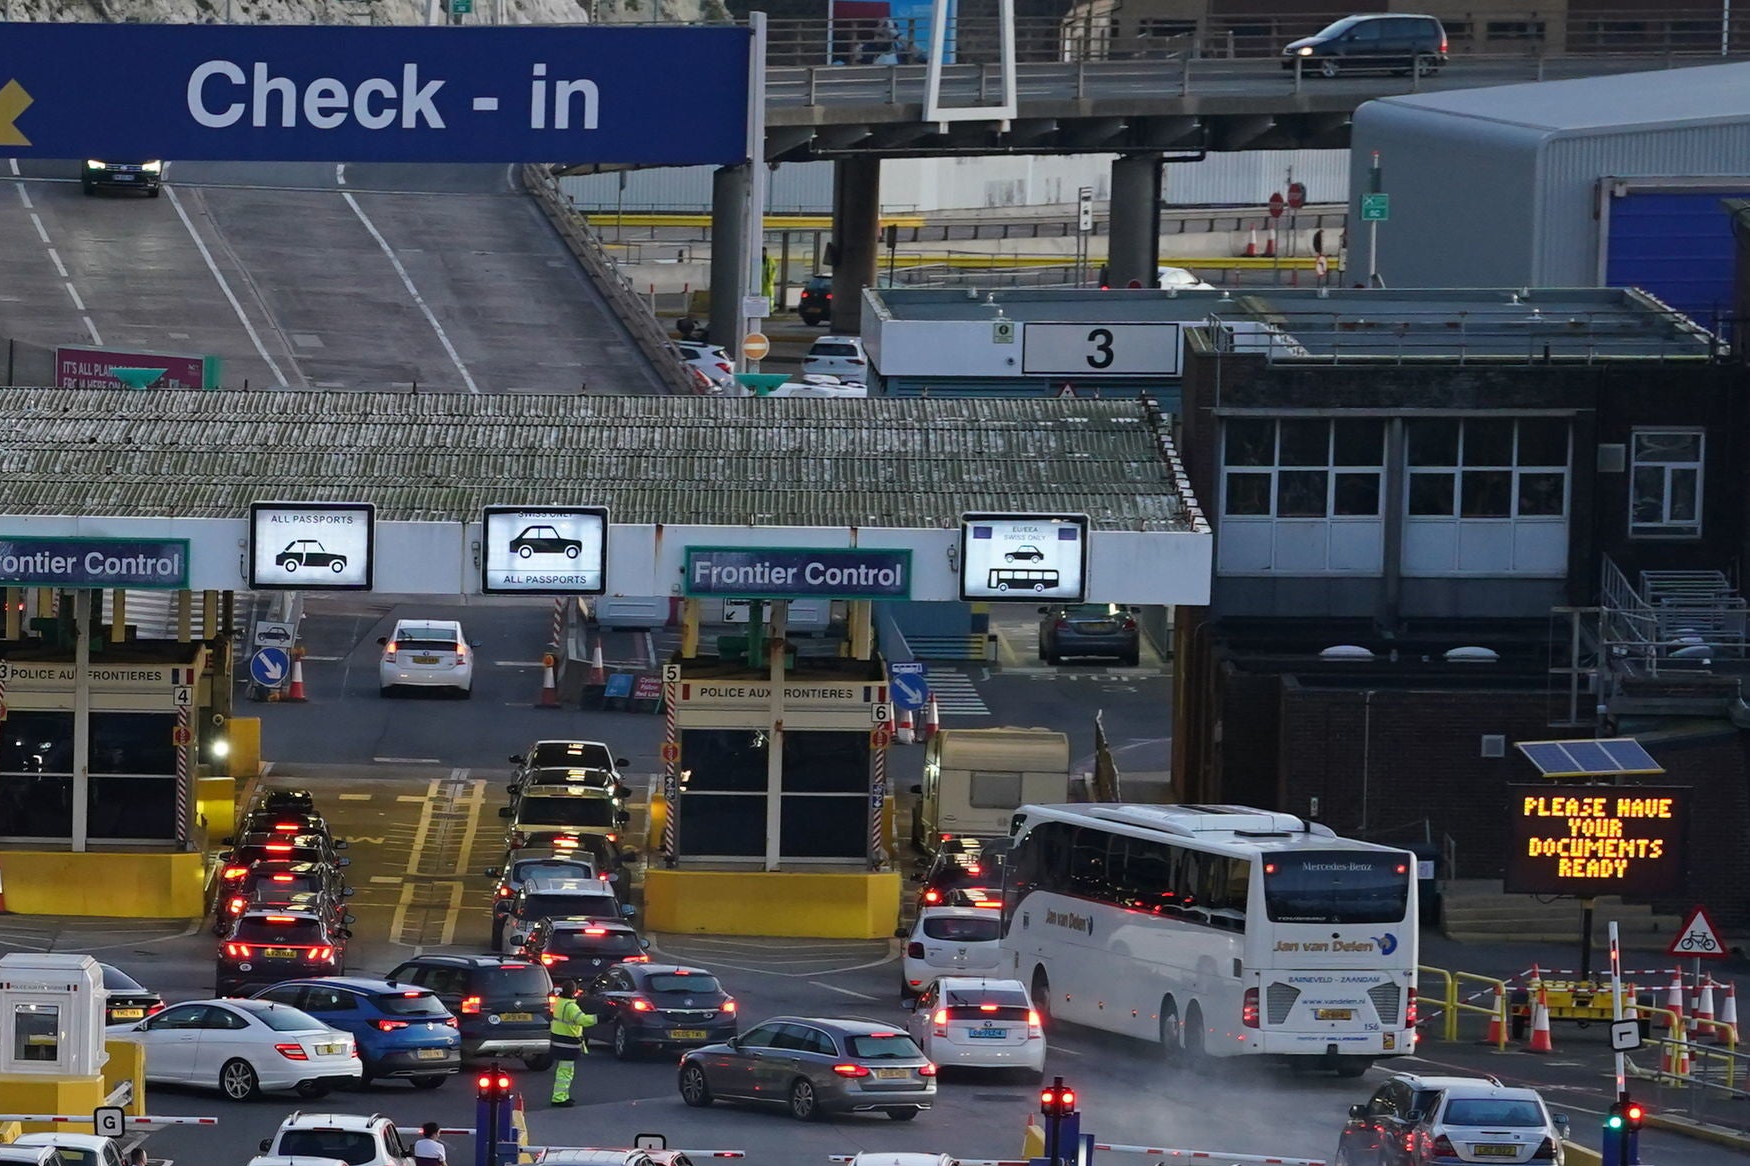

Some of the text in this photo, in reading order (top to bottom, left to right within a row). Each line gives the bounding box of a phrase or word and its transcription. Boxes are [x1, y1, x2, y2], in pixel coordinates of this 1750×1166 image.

[187, 59, 600, 130] Check - in
[1086, 328, 1114, 369] 3
[78, 363, 92, 376] ALL
[271, 515, 353, 524] ALL PASSPORTS
[84, 552, 179, 575] Control
[526, 576, 587, 584] PASSPORTS
[695, 561, 901, 586] Frontier Control
[11, 669, 55, 679] POLICE
[58, 670, 75, 680] AU
[666, 666, 676, 680] 5
[177, 690, 189, 703] 4
[700, 687, 853, 699] POLICE AUX RONTIERES
[876, 705, 886, 720] 6
[1523, 797, 1673, 818] PLEASE HAVE
[1567, 818, 1623, 838] YOUR
[1528, 838, 1663, 858] DOCUMENTS
[1302, 862, 1372, 872] Mercedes-Benz
[1558, 858, 1628, 878] READY
[1273, 940, 1373, 952] Jan van Delen
[1364, 1023, 1379, 1031] 156
[103, 1115, 116, 1130] G
